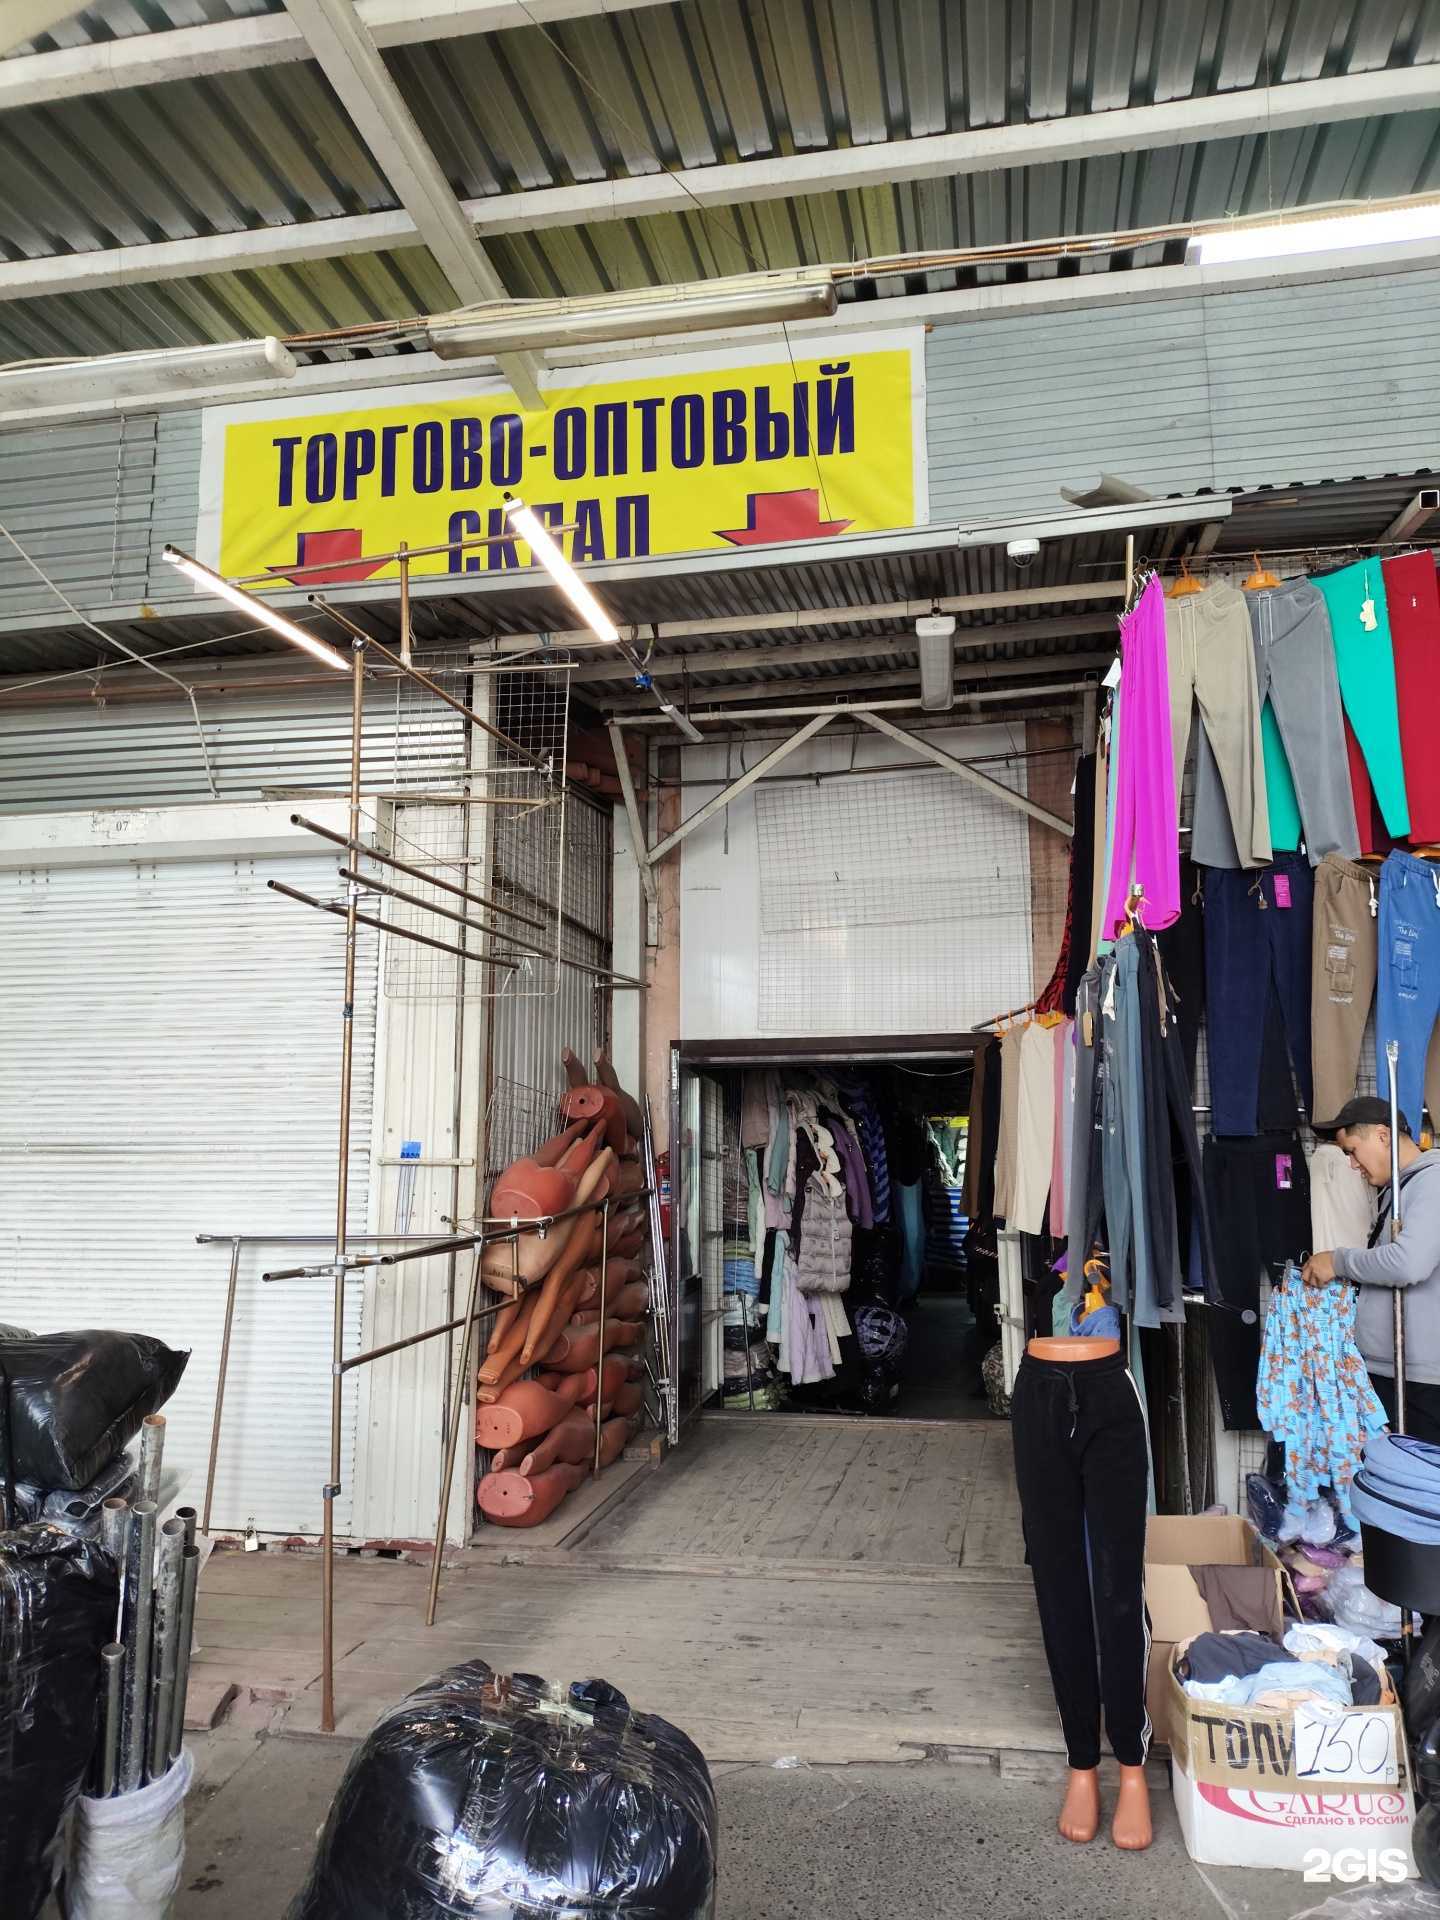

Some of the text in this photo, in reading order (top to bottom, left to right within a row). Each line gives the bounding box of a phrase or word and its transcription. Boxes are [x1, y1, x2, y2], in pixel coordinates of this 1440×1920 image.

[272, 361, 856, 507] ТОРГОВО-ОПТОВЫЙ
[1284, 1814, 1344, 1827] СДЕЛАНО
[1359, 1815, 1409, 1826] РОССИИ
